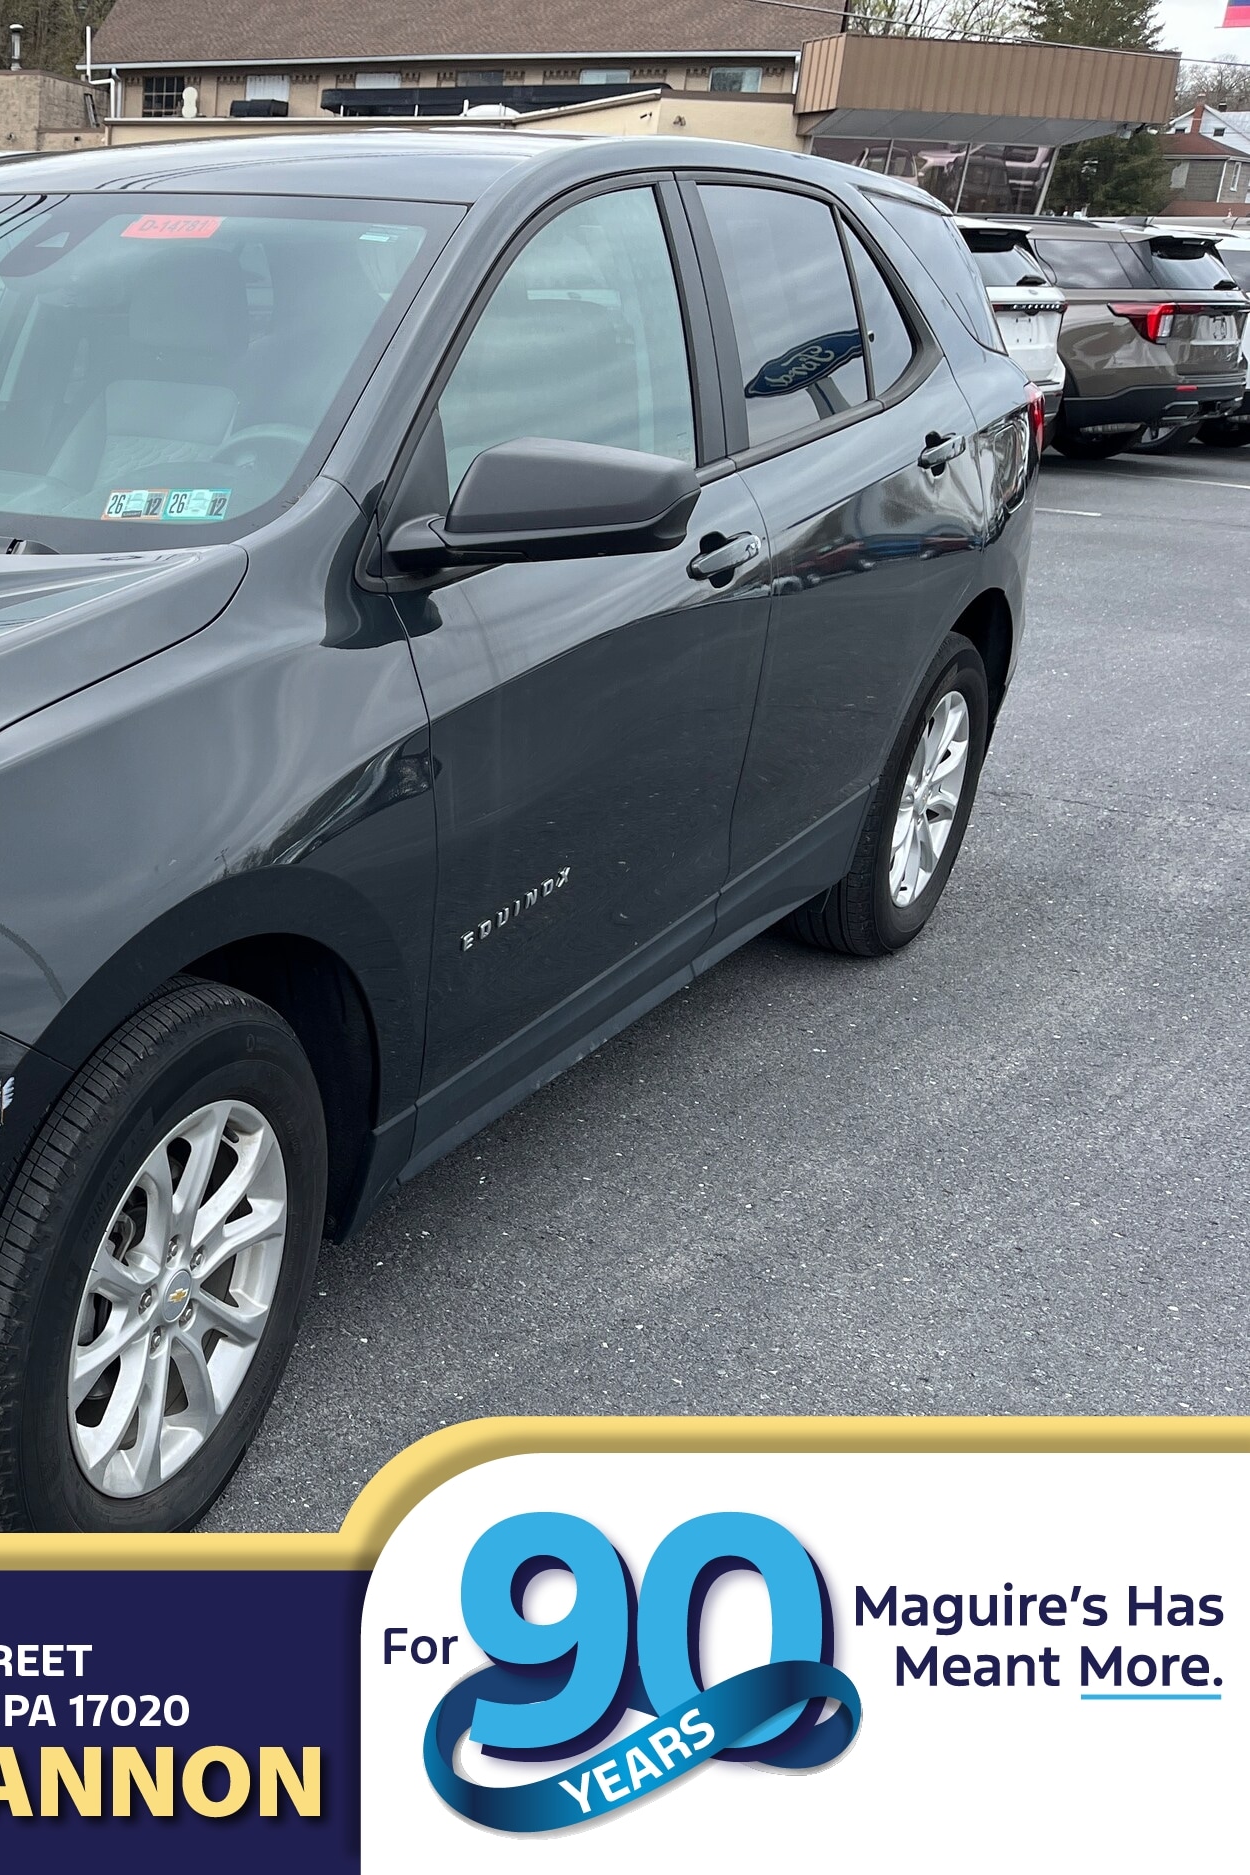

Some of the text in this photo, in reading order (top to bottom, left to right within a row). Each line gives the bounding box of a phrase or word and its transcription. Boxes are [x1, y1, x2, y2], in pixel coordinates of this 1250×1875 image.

[107, 495, 126, 514] 26
[144, 497, 162, 516] 12
[168, 493, 227, 516] 26 12
[460, 866, 571, 952] EQUINOX
